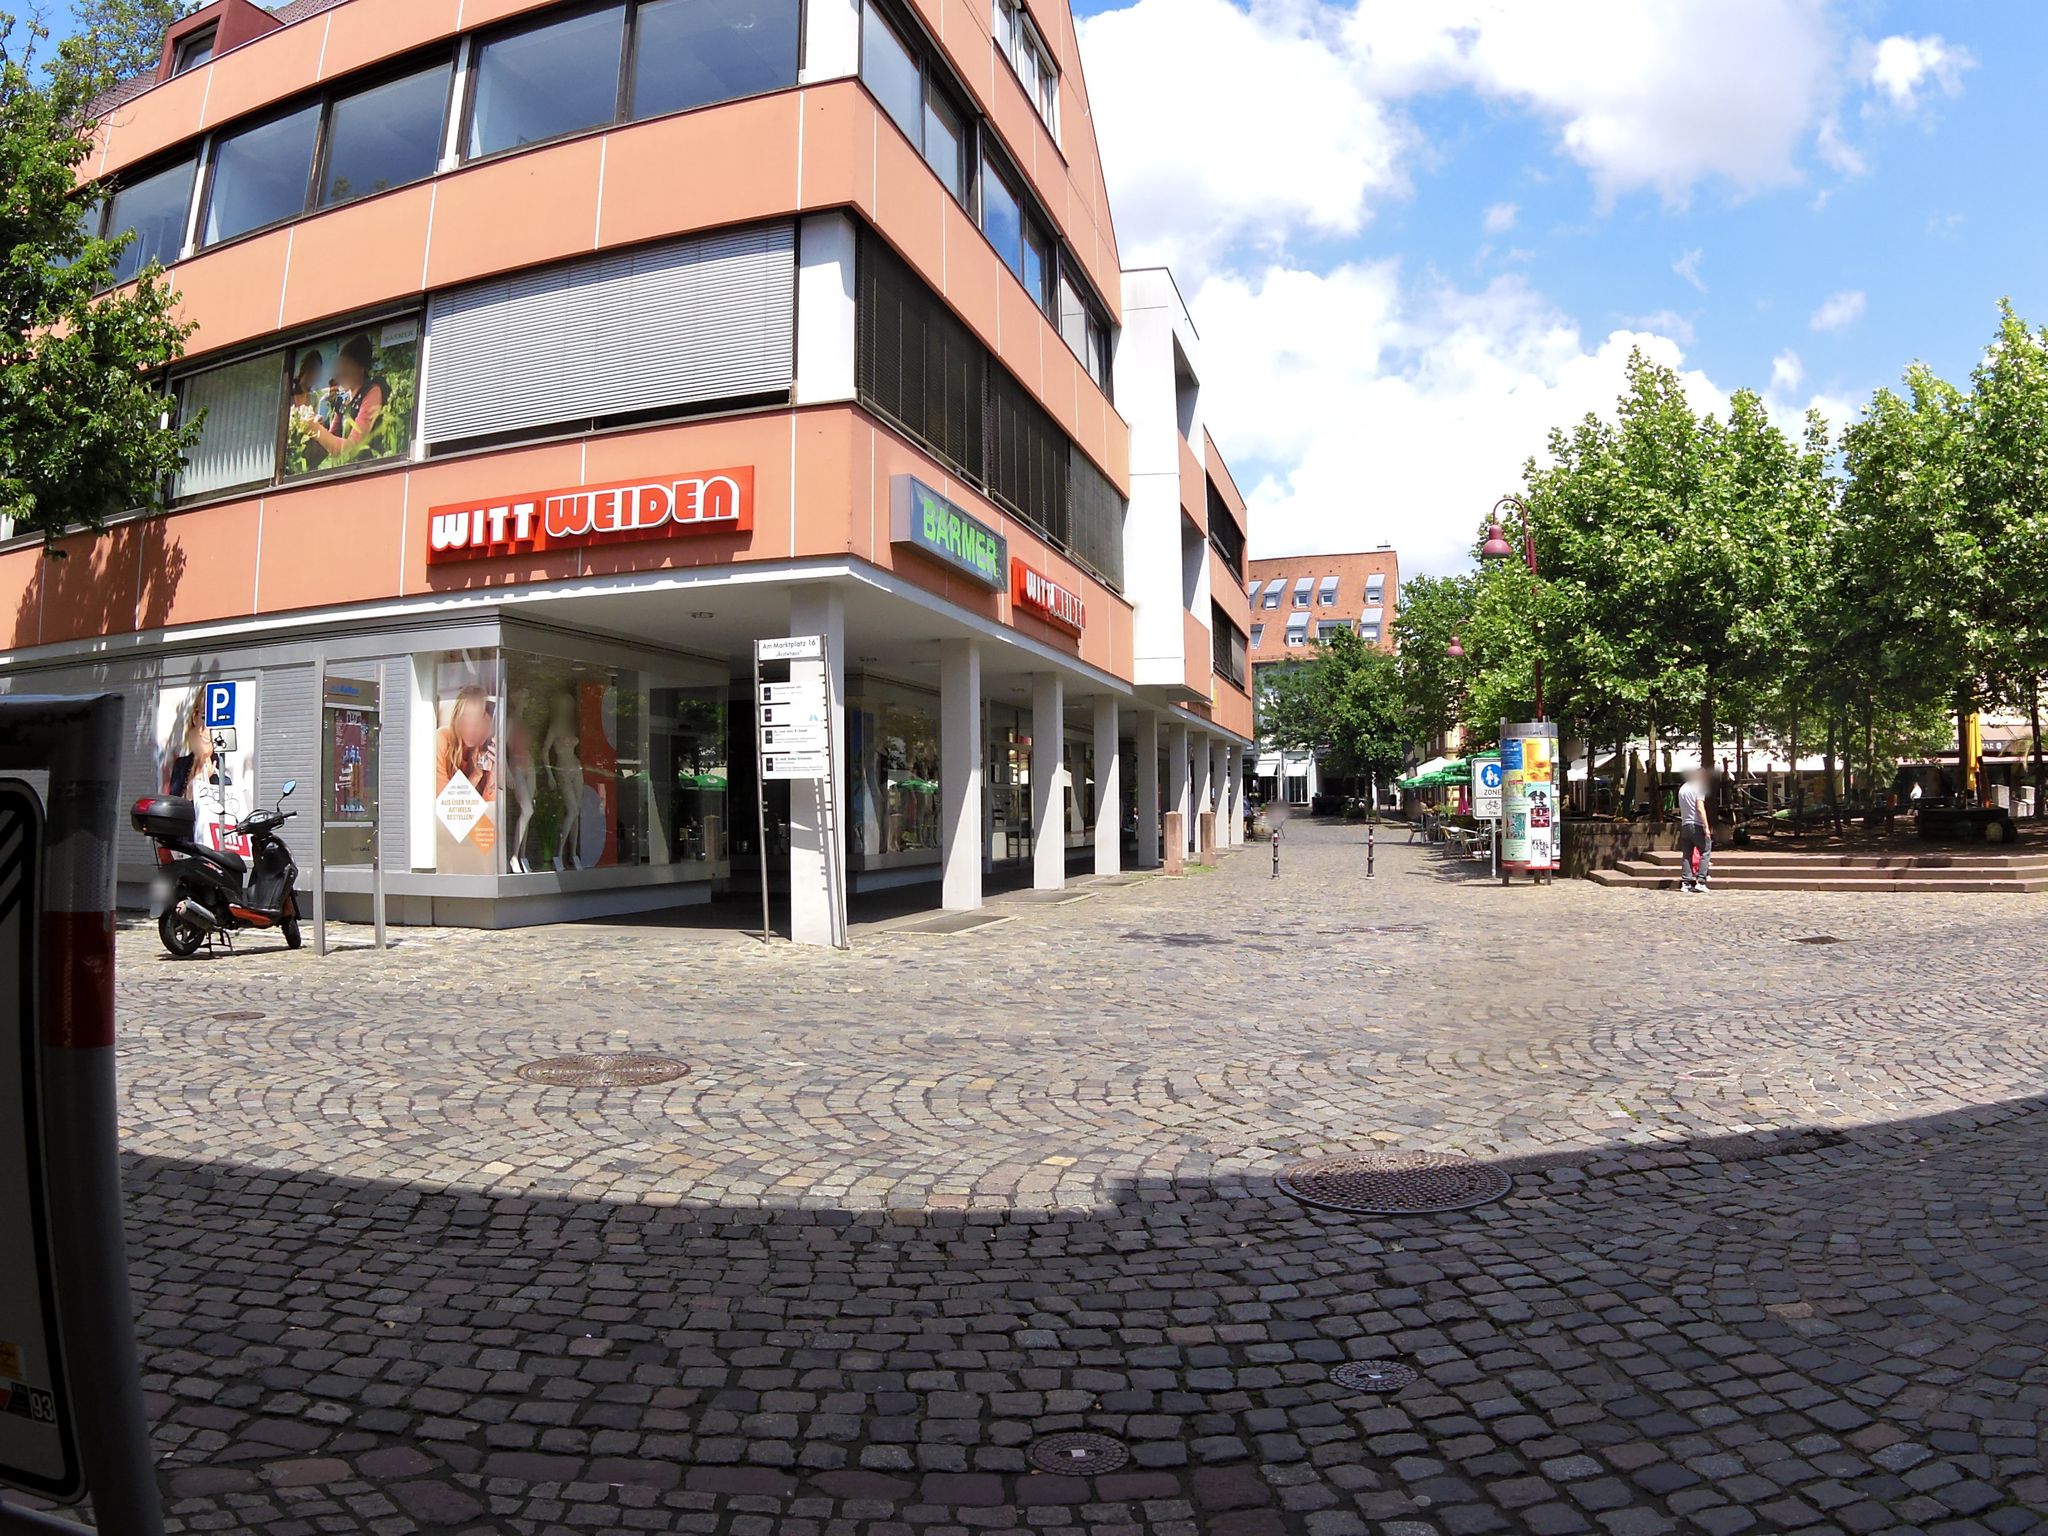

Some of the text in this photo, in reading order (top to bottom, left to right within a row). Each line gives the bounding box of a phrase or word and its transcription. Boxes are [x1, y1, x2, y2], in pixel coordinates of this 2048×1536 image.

[431, 475, 741, 551] WITT WEIDEN
[921, 496, 998, 577] BARMER
[1026, 569, 1087, 631] WITT WEIDEN
[773, 640, 806, 649] Marktplatz
[212, 687, 230, 722] P
[31, 1392, 54, 1421] 93
